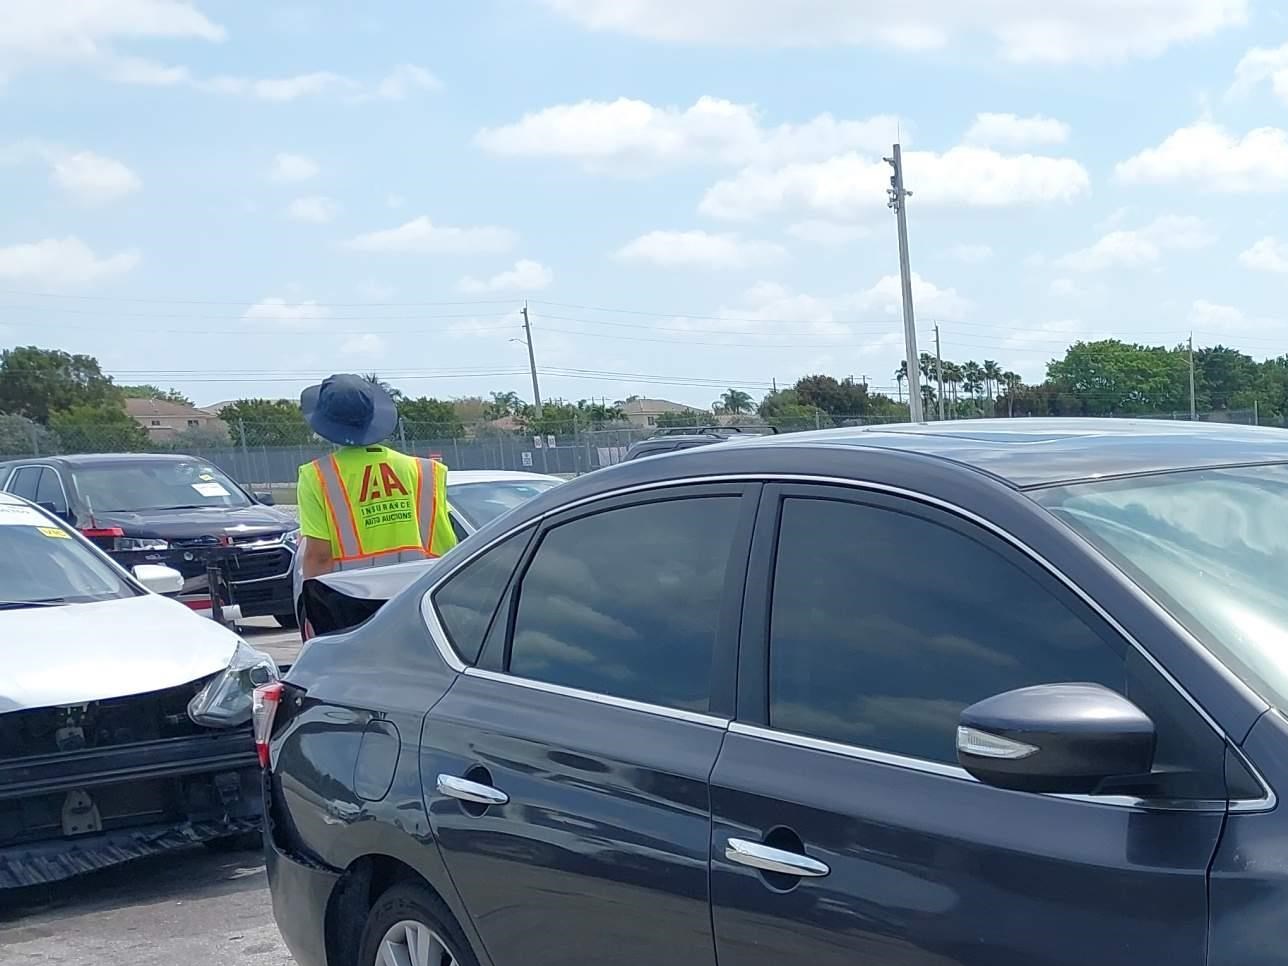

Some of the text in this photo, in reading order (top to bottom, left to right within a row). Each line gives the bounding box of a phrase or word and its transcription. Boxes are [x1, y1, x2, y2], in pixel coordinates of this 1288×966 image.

[360, 501, 410, 516] INSURANCE
[364, 511, 412, 527] AUTO AUCTIONS
